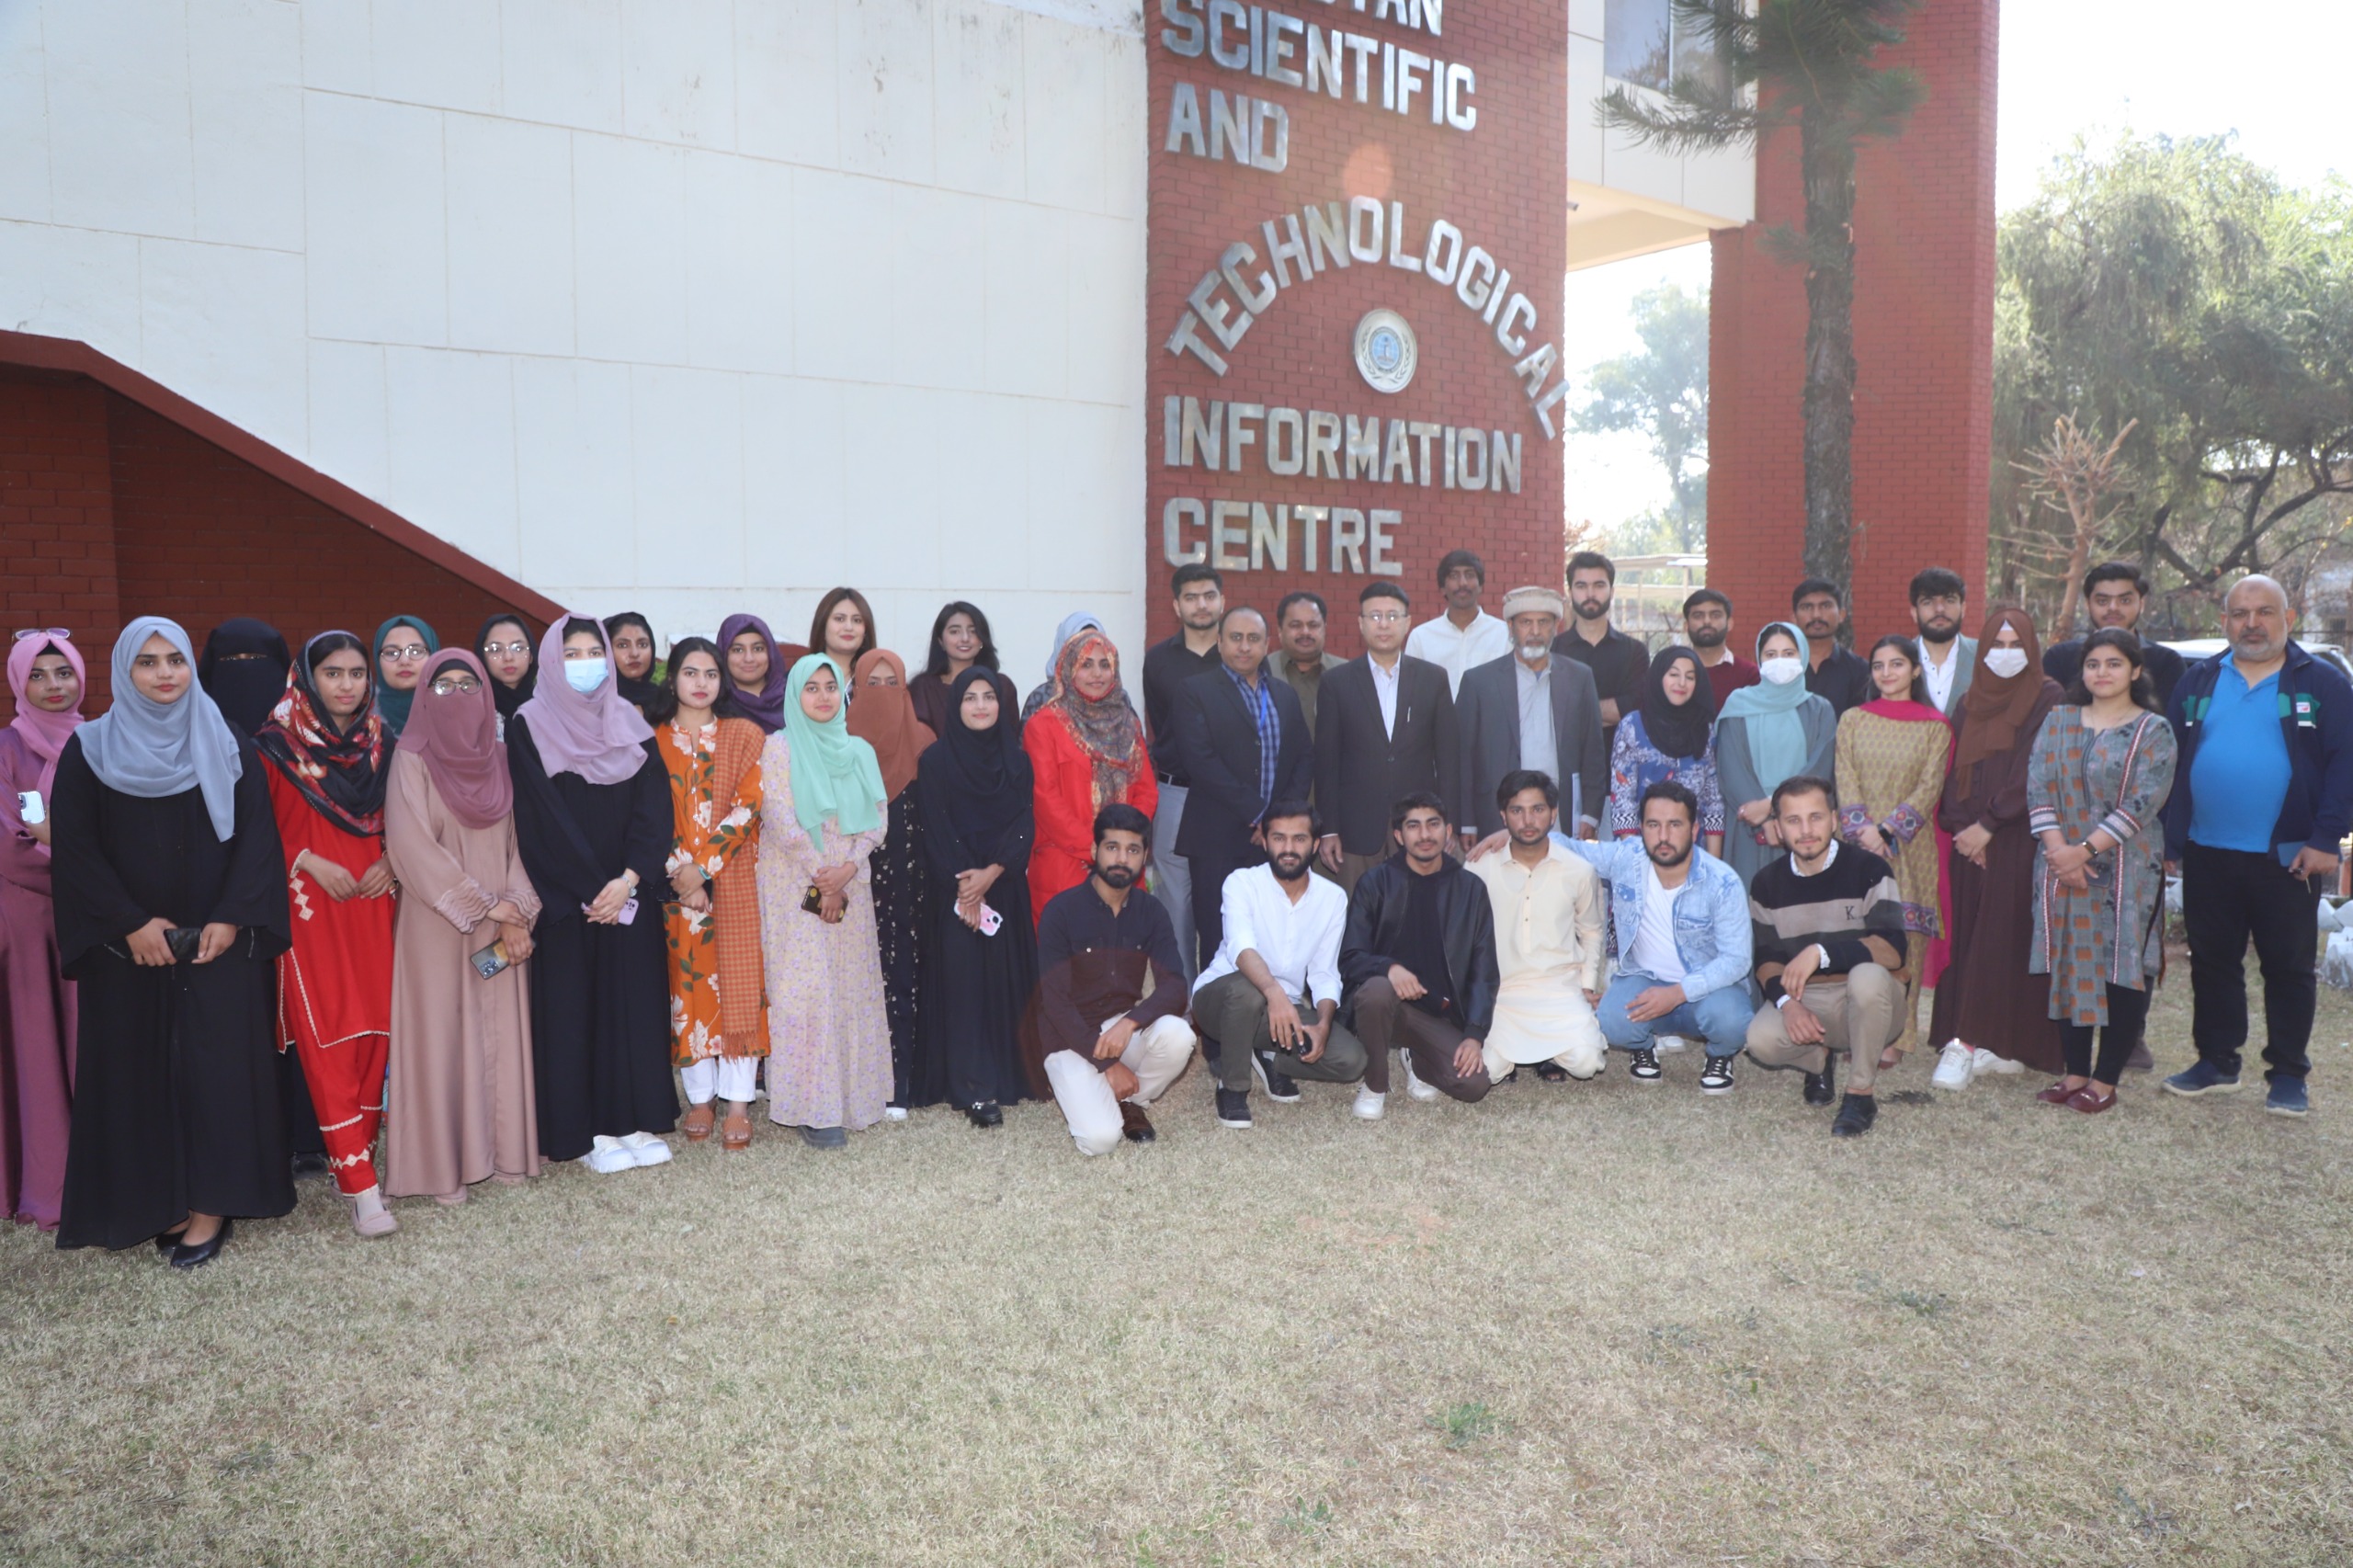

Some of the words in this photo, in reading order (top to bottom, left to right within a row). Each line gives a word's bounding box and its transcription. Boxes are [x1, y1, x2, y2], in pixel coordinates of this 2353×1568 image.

[1160, 0, 1477, 131] SCIENTIFIC
[1165, 82, 1289, 173] AND
[1164, 195, 1571, 440] TECHNOLOGICAL
[1164, 395, 1522, 494] INFORMATION
[1163, 497, 1403, 576] CENTRE
[1845, 905, 1855, 921] K
